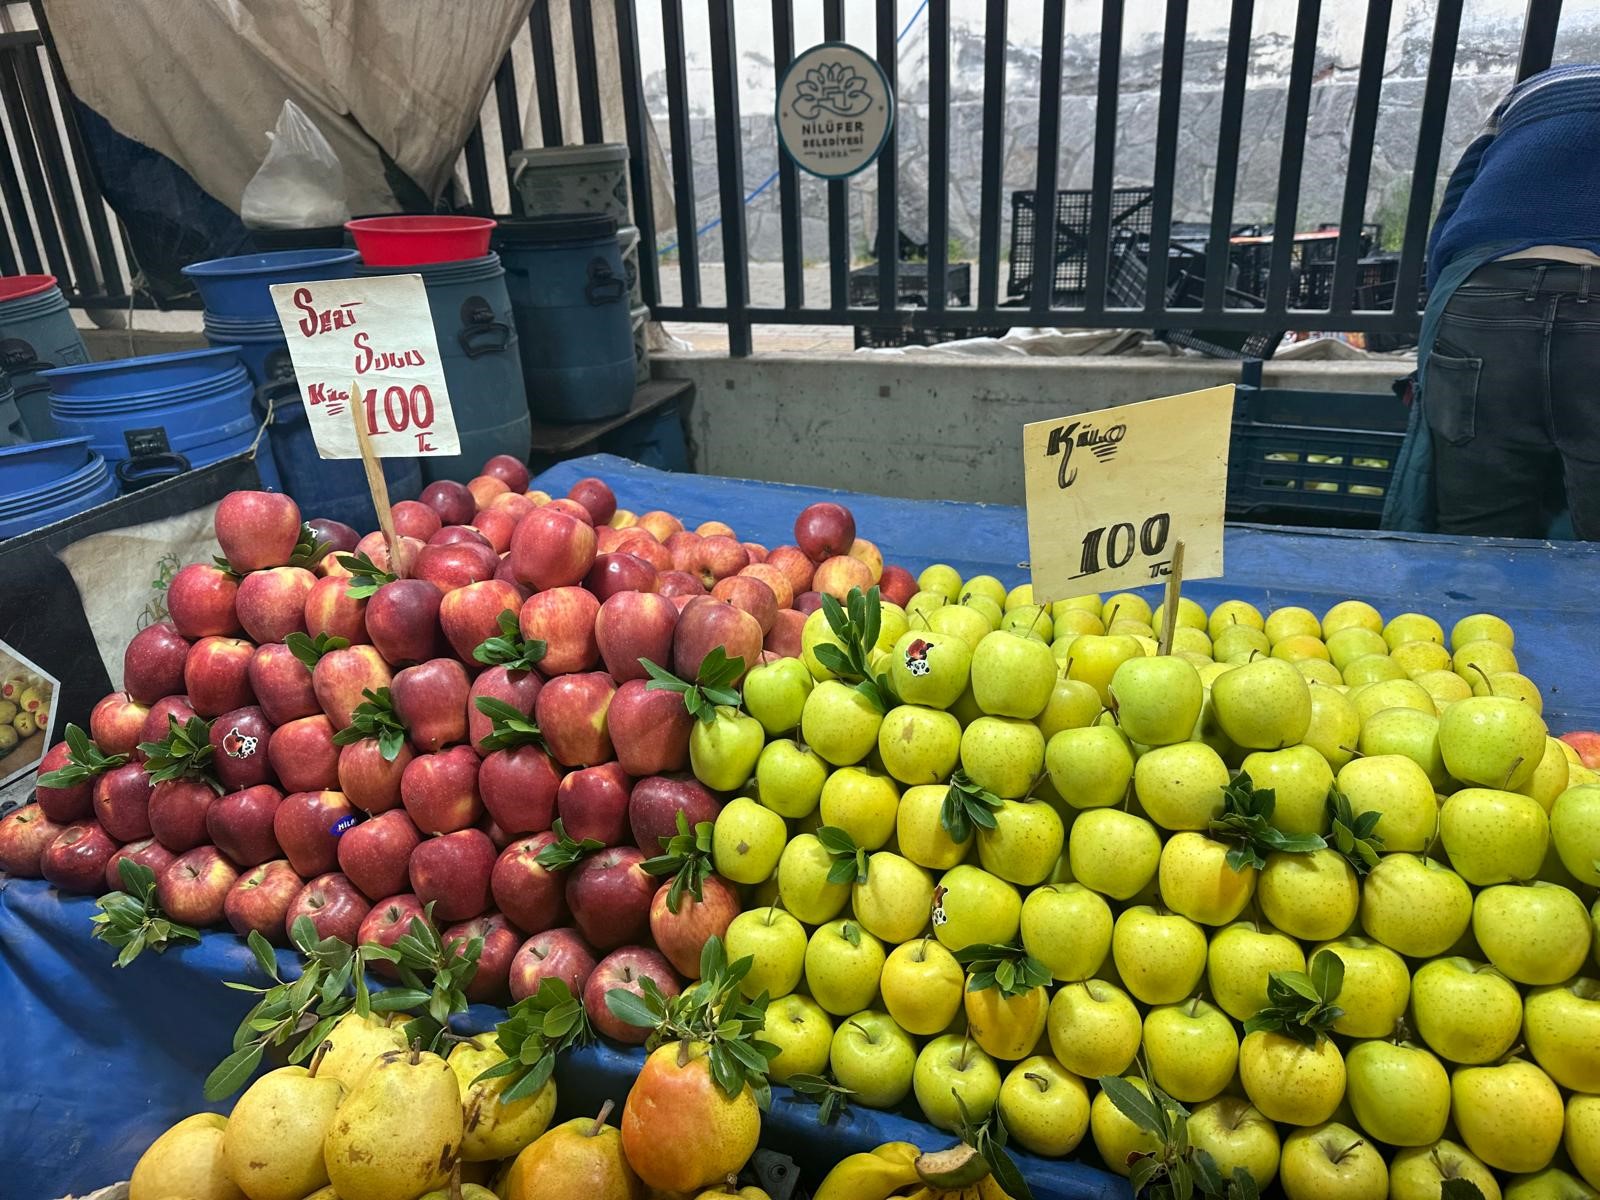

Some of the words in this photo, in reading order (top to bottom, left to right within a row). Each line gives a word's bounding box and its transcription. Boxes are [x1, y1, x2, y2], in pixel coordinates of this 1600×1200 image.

[802, 119, 864, 136] NİLÜFER
[362, 384, 435, 436] 100
[1068, 512, 1171, 580] 100
